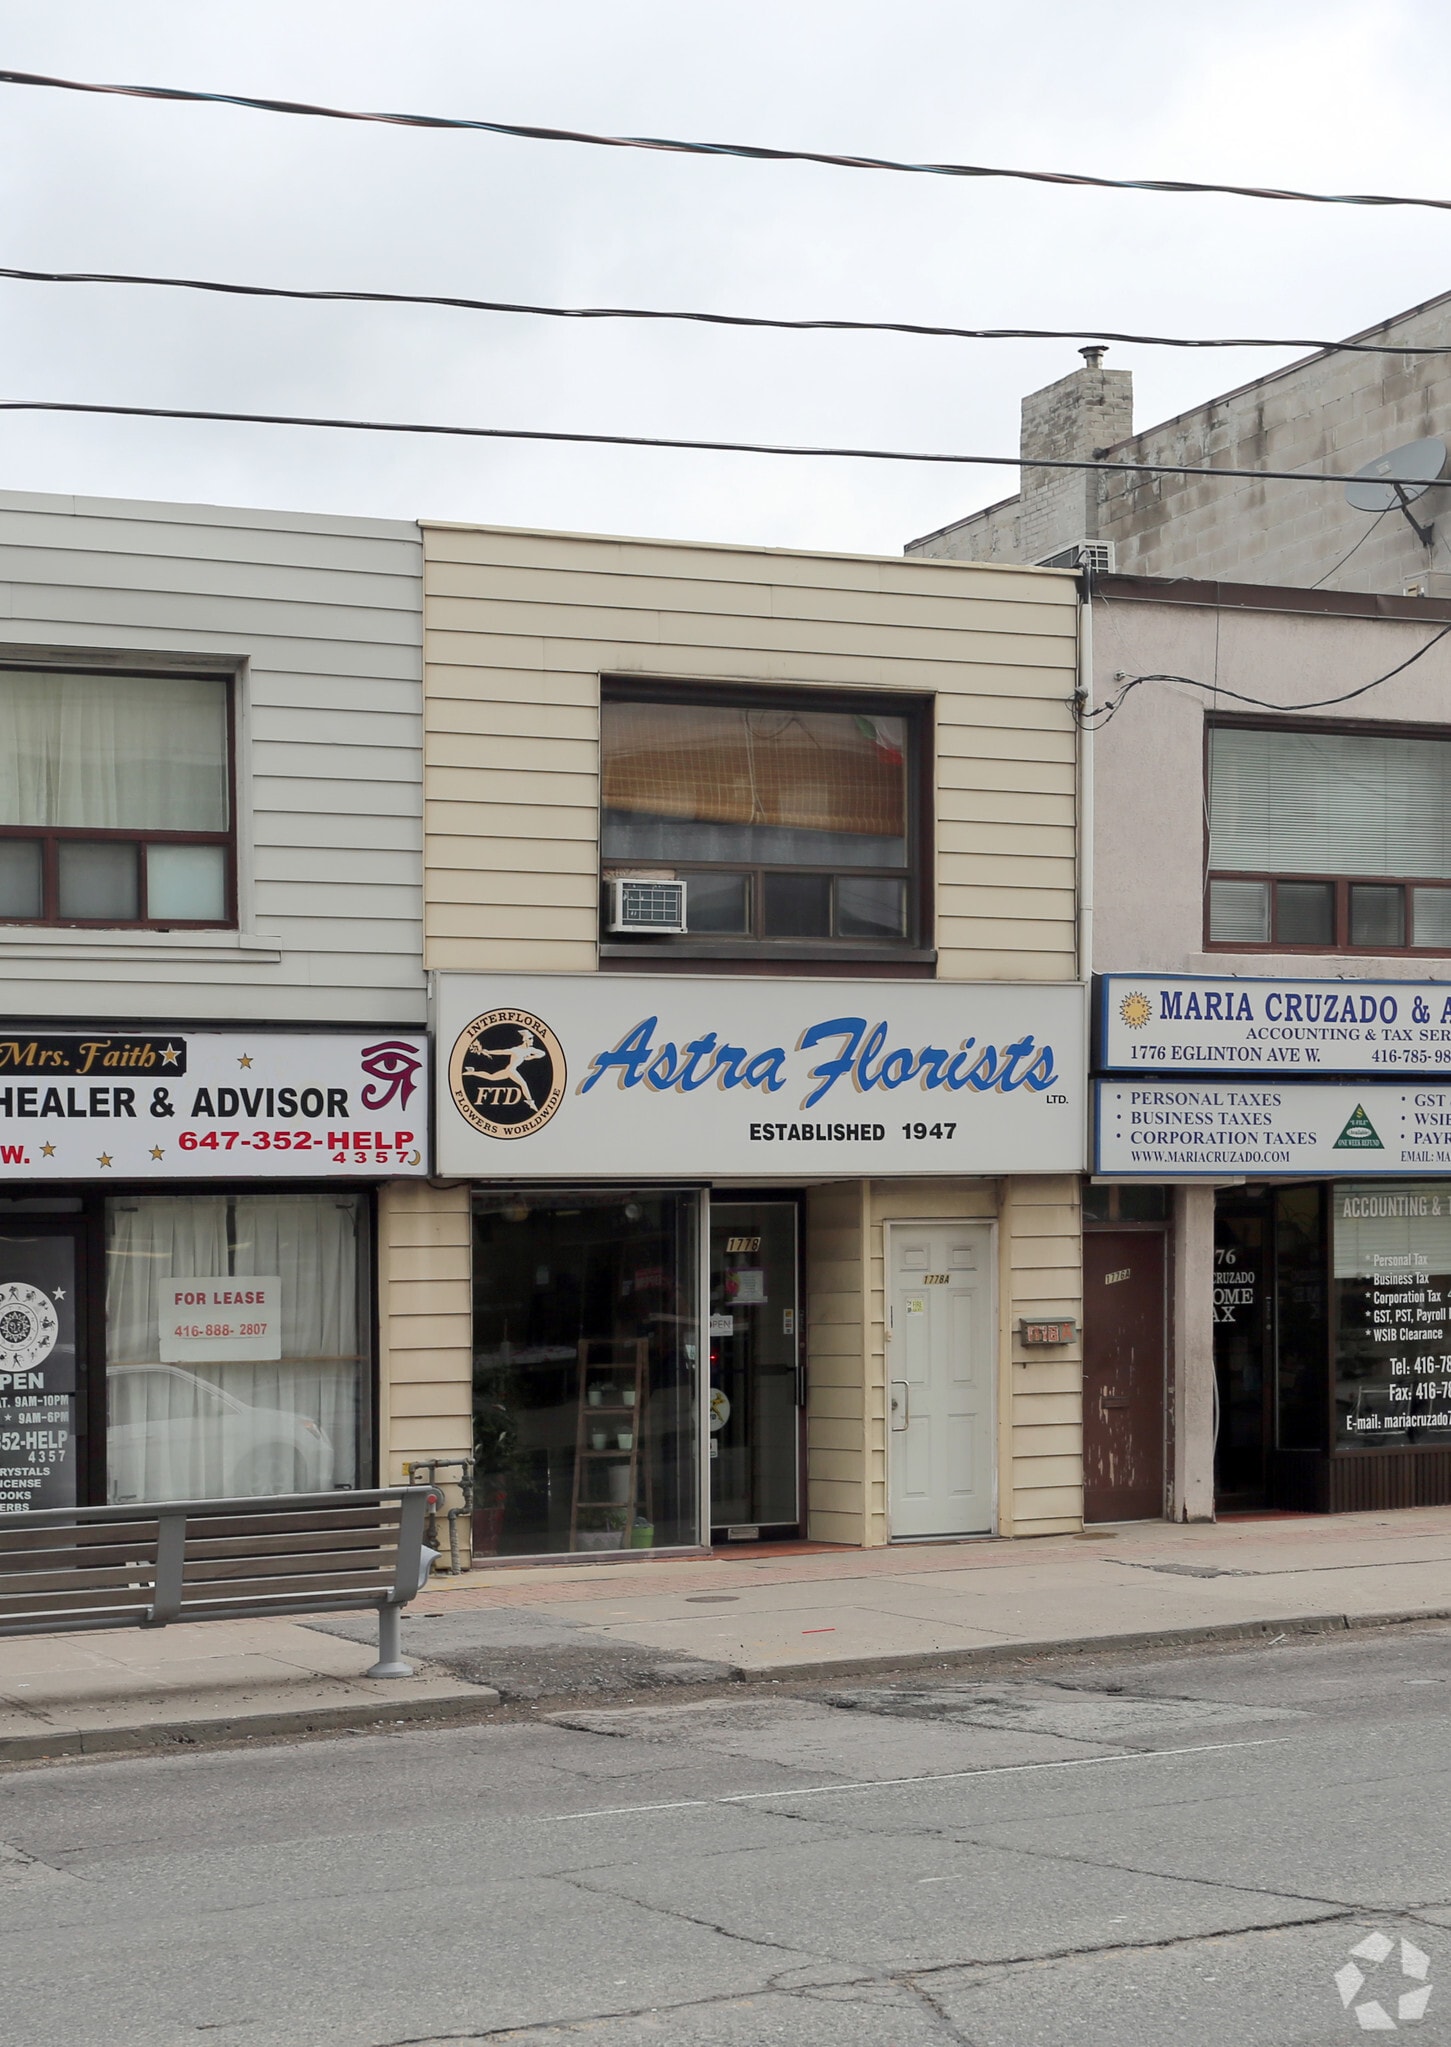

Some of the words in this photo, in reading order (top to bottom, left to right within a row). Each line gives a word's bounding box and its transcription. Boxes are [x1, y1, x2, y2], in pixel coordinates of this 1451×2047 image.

[1160, 991, 1254, 1021] MARIA
[1265, 993, 1398, 1024] CRUZADO
[1411, 995, 1430, 1024] &
[466, 1011, 548, 1038] INTERFLORA
[1245, 1027, 1360, 1041] ACCOUNTING
[1364, 1028, 1377, 1041] &
[1381, 1029, 1413, 1041] TAX
[1419, 1029, 1451, 1041] SER
[0, 1041, 70, 1068] Mrs.
[76, 1039, 157, 1075] Faith
[1131, 1045, 1166, 1060] 1776
[1171, 1046, 1262, 1062] EGLINTON
[1266, 1047, 1301, 1063] AVE
[1304, 1048, 1321, 1063] W.
[575, 1015, 787, 1096] Astra
[794, 1016, 1059, 1111] Florists
[0, 1087, 137, 1118] HEALER
[150, 1087, 175, 1118] &
[191, 1087, 350, 1118] ADVISOR
[474, 1087, 522, 1105] FTD
[1046, 1094, 1069, 1105] LTD.
[1130, 1091, 1224, 1106] PERSONAL
[1227, 1093, 1282, 1107] TAXES
[1414, 1093, 1446, 1107] GST
[455, 1090, 499, 1134] FLOWERS
[503, 1088, 561, 1135] WORLDWIDE
[1130, 1111, 1214, 1126] BUSINESS
[1218, 1112, 1272, 1126] TAXES
[750, 1123, 885, 1141] ESTABLISHED
[901, 1122, 957, 1140] 1947
[1130, 1130, 1258, 1145] CORPORATION
[1263, 1131, 1318, 1145] TAXES
[178, 1131, 414, 1151] 647-352-HELP
[0, 1145, 30, 1164] W.
[1131, 1150, 1291, 1163] WWW.MARIACRUZADO.COM
[1401, 1150, 1434, 1162] EMAIL:
[1342, 1196, 1427, 1218] ACCOUNTING
[1432, 1195, 1441, 1216] &
[728, 1238, 760, 1251] 1778
[1215, 1249, 1236, 1265] 76
[1373, 1253, 1411, 1267] Personal
[1413, 1253, 1428, 1266] Tax
[1105, 1268, 1131, 1285] 1776A
[1373, 1271, 1413, 1286] Business
[1415, 1271, 1429, 1284] Tax
[174, 1292, 206, 1305] FOR
[213, 1291, 265, 1305] LEASE
[1373, 1290, 1425, 1306] Corporation
[1427, 1289, 1442, 1302] Tax
[1373, 1309, 1393, 1325] GST,
[1395, 1308, 1414, 1324] PST,
[1416, 1307, 1446, 1324] Payroll
[239, 1323, 268, 1336] 2807
[1373, 1328, 1397, 1342] WSIB
[1399, 1327, 1444, 1341] Clearance
[1389, 1357, 1410, 1375] Tel:
[1389, 1383, 1412, 1401] Fax:
[14, 1394, 69, 1408] 9AM-10PM
[18, 1410, 70, 1424] 9AM-6PM
[1346, 1413, 1381, 1430] E-mail:
